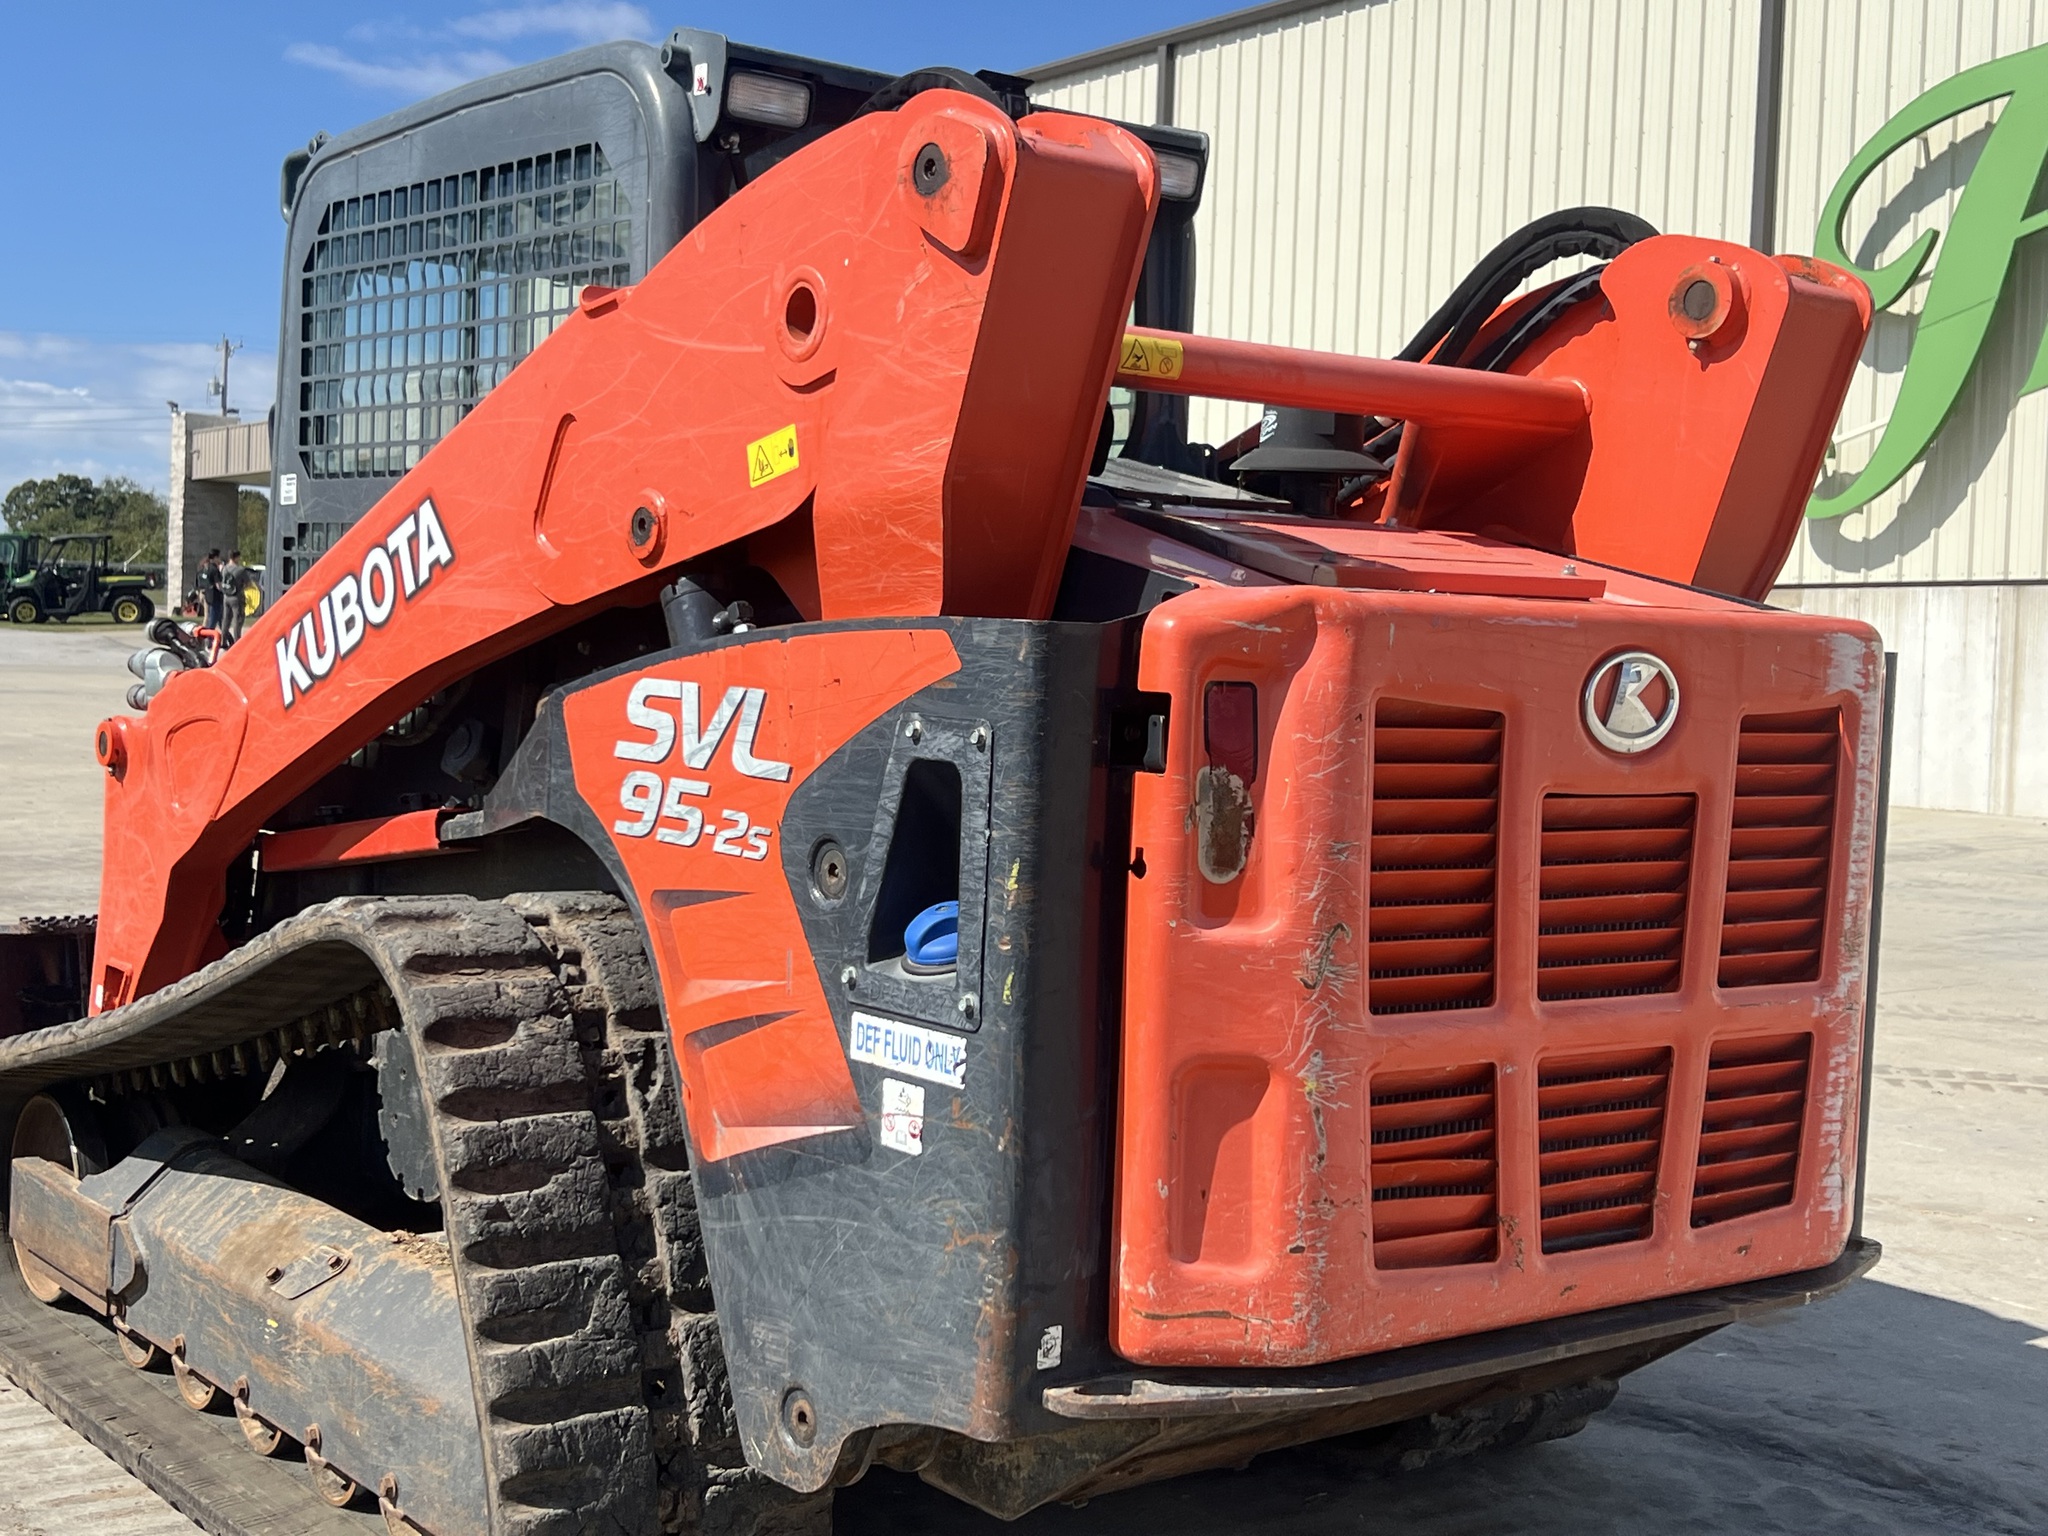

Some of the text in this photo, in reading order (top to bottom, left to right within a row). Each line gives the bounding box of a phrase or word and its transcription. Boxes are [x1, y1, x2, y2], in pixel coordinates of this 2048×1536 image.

[275, 498, 455, 708] KUBOTA
[613, 677, 793, 783] SVL
[856, 1021, 962, 1077] DEF FLUID ONLY
